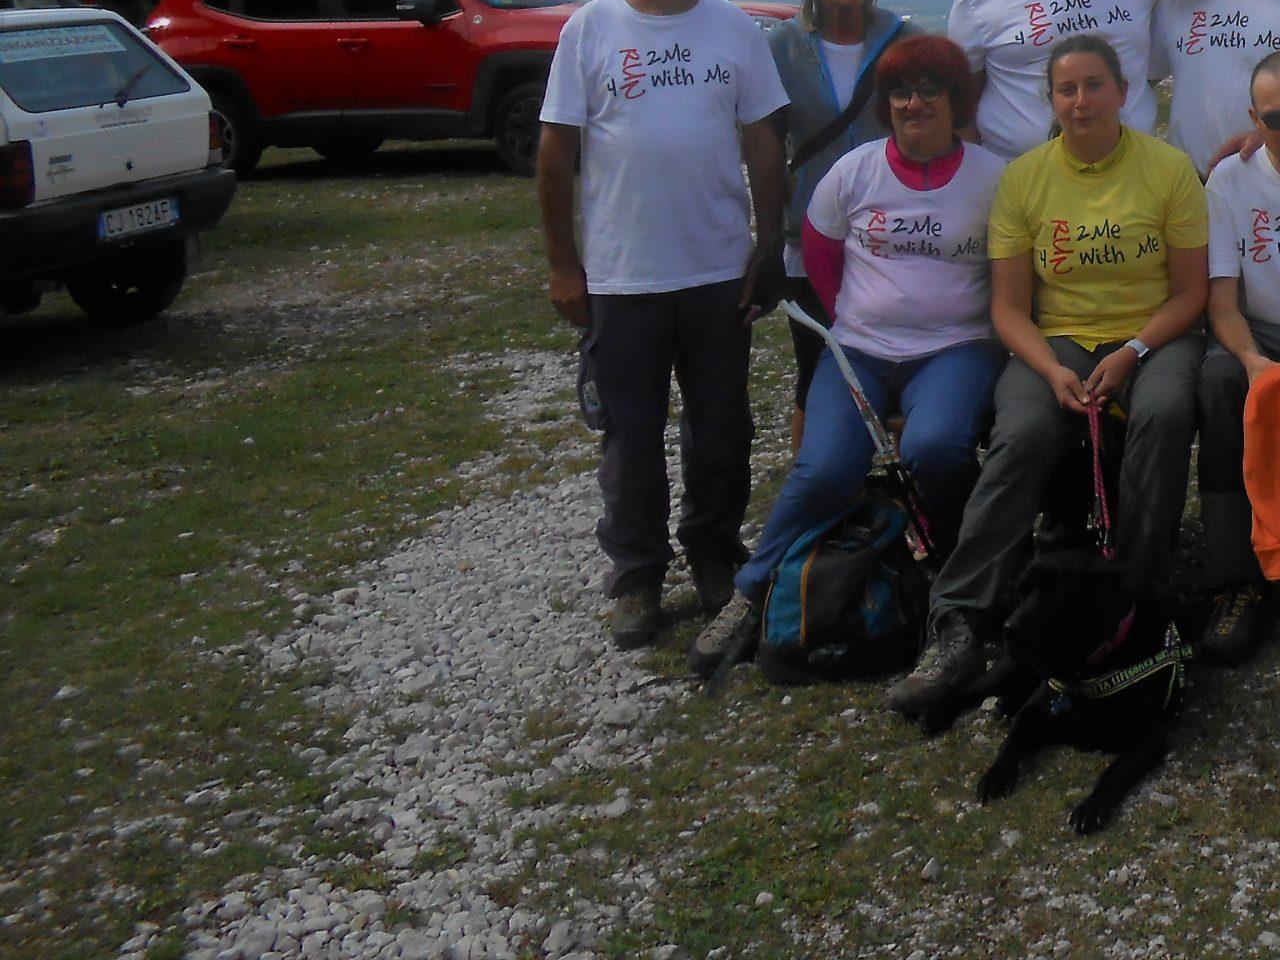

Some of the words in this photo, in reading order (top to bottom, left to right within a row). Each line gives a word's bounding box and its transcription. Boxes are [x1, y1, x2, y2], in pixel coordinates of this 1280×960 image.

[1057, 13, 1098, 34] With
[1107, 5, 1132, 23] Me
[1210, 30, 1246, 49] With
[1253, 30, 1280, 50] Me
[651, 67, 694, 87] With
[704, 64, 730, 84] Me
[894, 240, 940, 257] With
[952, 237, 979, 257] Me
[1079, 244, 1125, 265] With
[1136, 234, 1160, 259] Me
